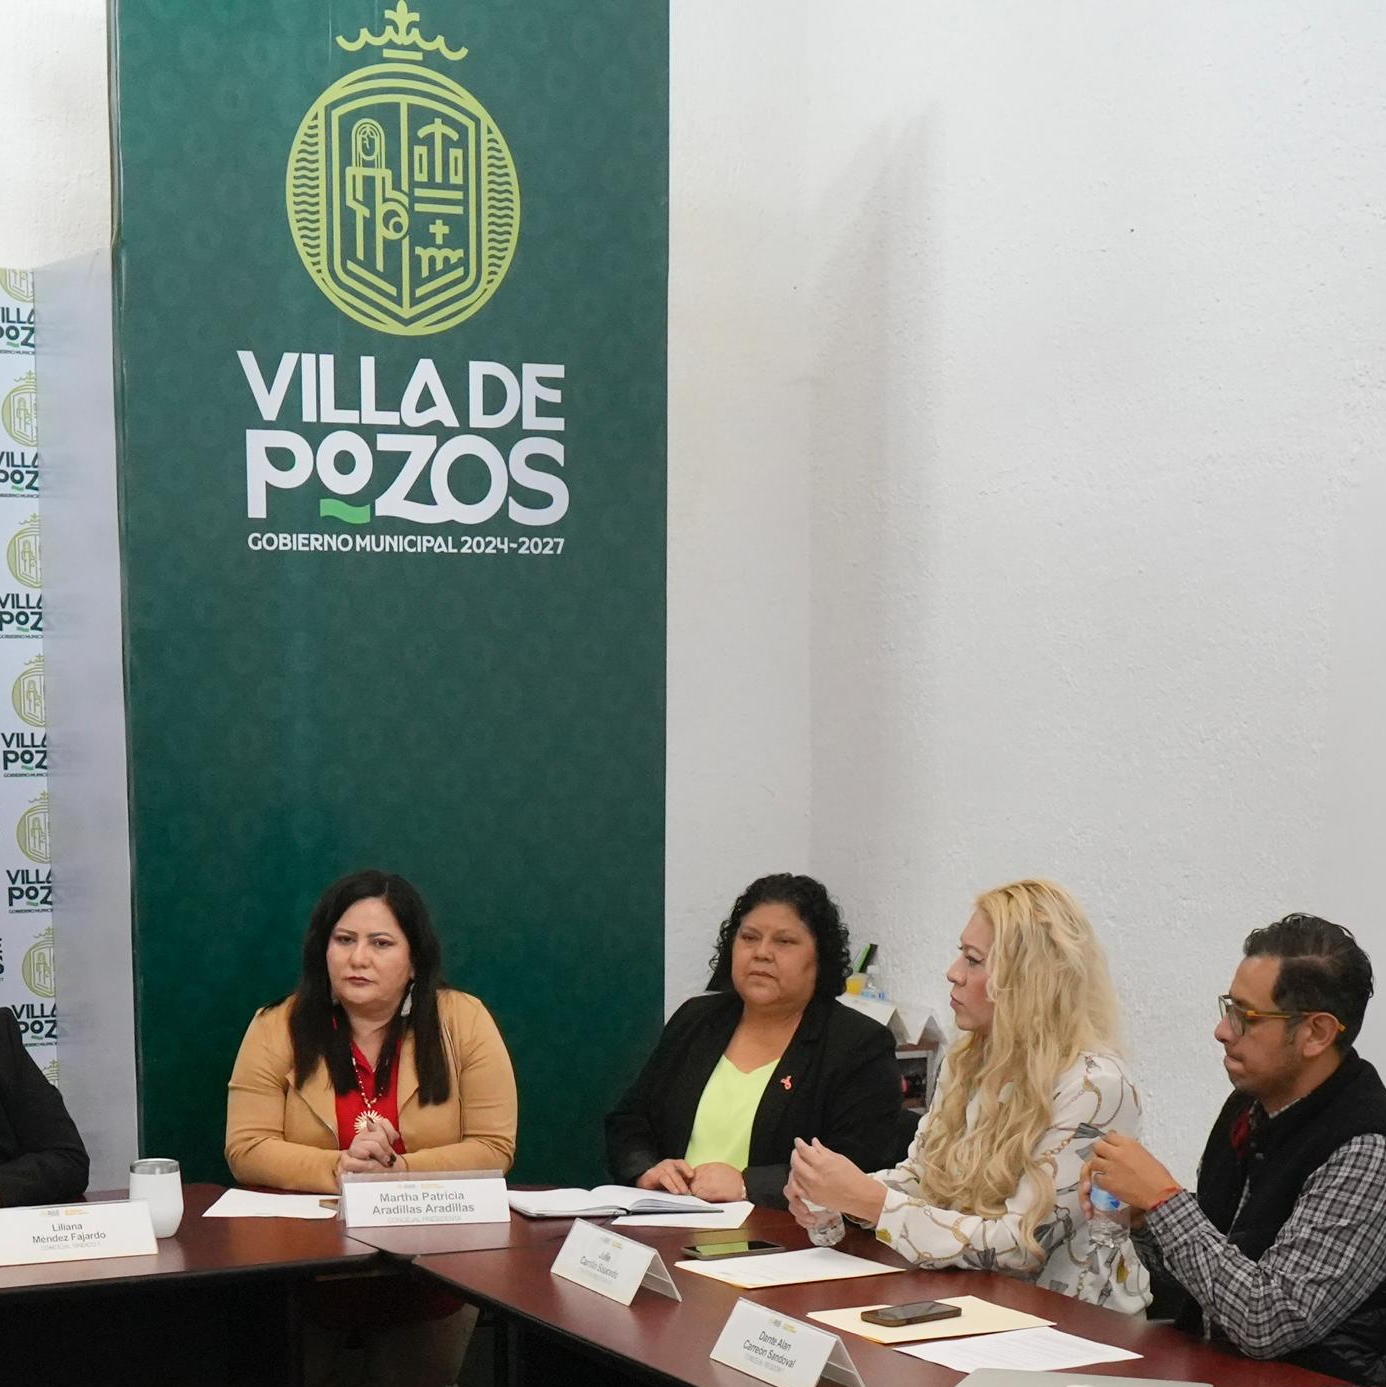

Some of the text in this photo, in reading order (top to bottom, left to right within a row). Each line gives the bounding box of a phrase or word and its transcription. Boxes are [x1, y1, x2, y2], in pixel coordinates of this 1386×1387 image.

[237, 350, 565, 431] VILLA DE
[246, 429, 570, 526] POZOS
[248, 532, 565, 555] GOBIERNO MUNICIPAL 2024-2027
[380, 1191, 464, 1203] Martha Patricia
[373, 1203, 475, 1215] Aradillas Aradillas
[52, 1223, 83, 1232] Liliana
[71, 1231, 107, 1242] Fajardo
[758, 1330, 792, 1352] Dante Alan
[767, 1348, 796, 1369] Sandoval
